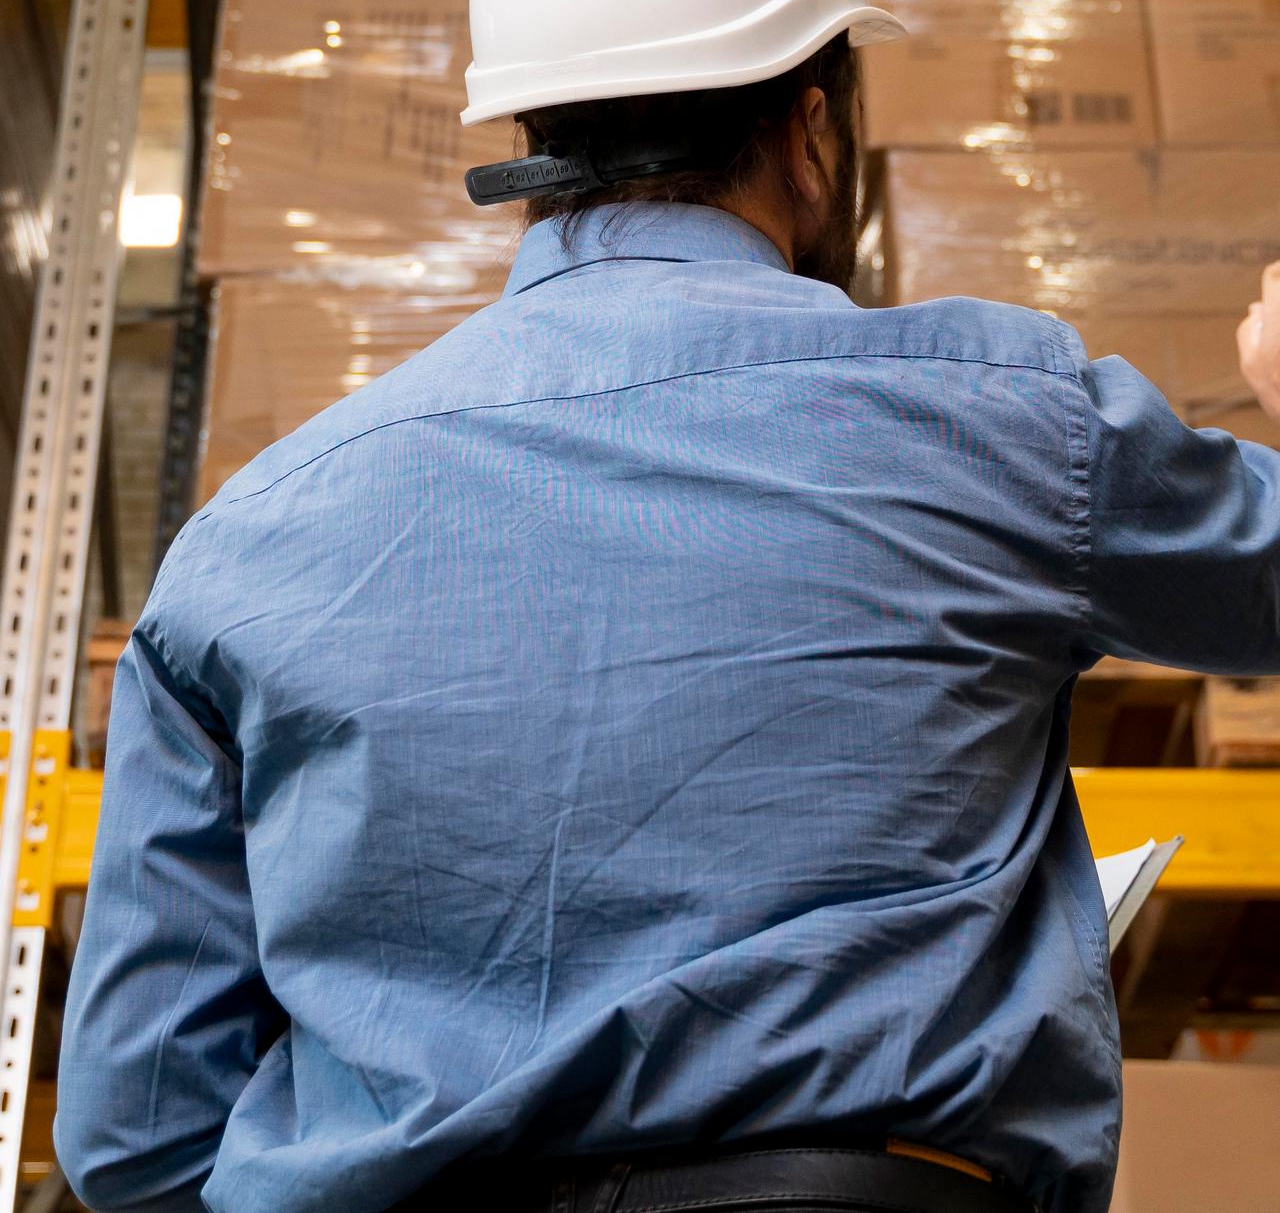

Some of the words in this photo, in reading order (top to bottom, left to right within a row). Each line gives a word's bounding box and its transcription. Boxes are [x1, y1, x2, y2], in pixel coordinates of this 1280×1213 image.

[531, 171, 539, 180] 61
[545, 167, 554, 177] 60
[560, 164, 569, 174] 59
